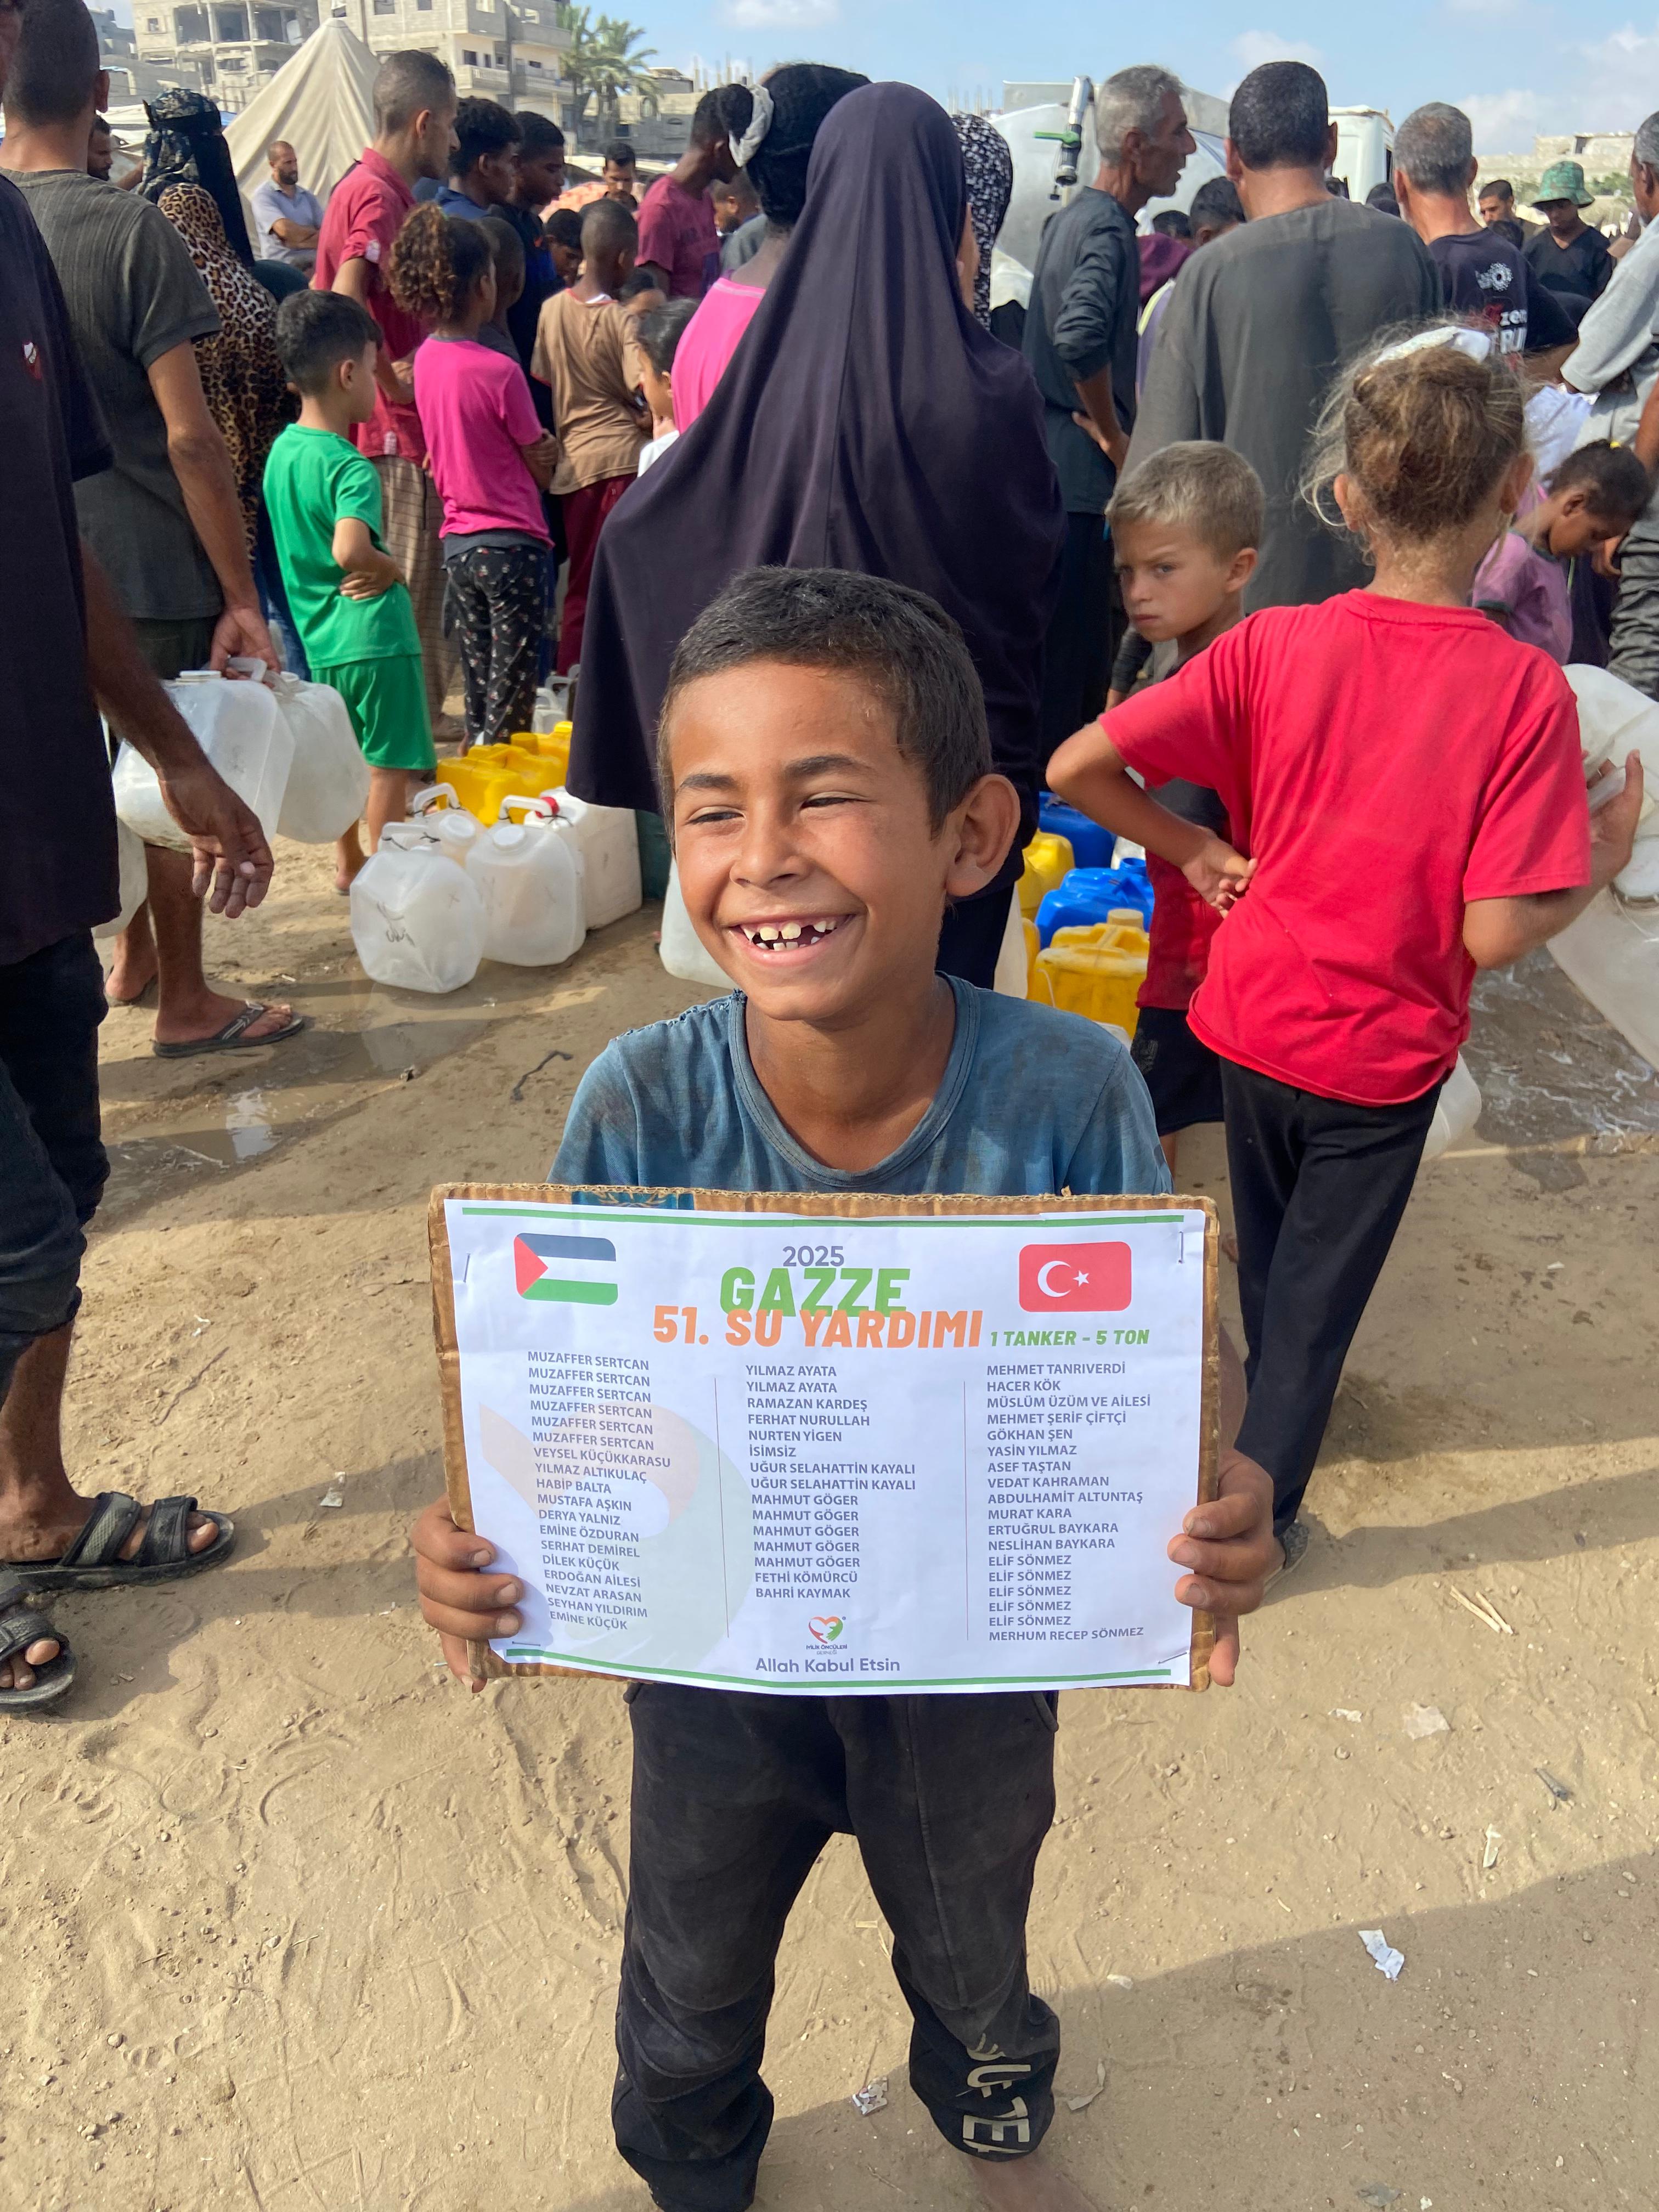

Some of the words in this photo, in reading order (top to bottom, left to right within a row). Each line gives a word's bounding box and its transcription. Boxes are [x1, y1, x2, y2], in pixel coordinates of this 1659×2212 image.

[783, 1246, 844, 1267] 2025
[719, 1267, 911, 1317] GAZZE
[653, 1306, 708, 1345] 51.
[725, 1310, 783, 1347] SU
[799, 1310, 983, 1348] YARDIMI
[991, 1331, 998, 1346] 1
[1002, 1330, 1077, 1346] TANKER
[1096, 1330, 1107, 1345] 5
[1112, 1329, 1150, 1345] TON
[528, 1351, 592, 1365] MUZAFFER
[595, 1356, 649, 1370] SERTCAN
[746, 1365, 795, 1376] YILMAZ
[798, 1365, 837, 1376] AYATA
[987, 1364, 1045, 1375] MEHMET
[1046, 1361, 1125, 1374] TANRIVERDİ
[529, 1368, 594, 1381] MUZAFFER
[596, 1373, 650, 1386] SERTCAN
[746, 1381, 795, 1392] YILMAZ
[798, 1379, 837, 1393] AYATA
[988, 1379, 1032, 1392] HACER
[1034, 1378, 1060, 1391] KÖK
[530, 1384, 594, 1398] MUZAFFER
[597, 1389, 651, 1402] SERTCAN
[747, 1398, 812, 1409] RAMAZAN
[816, 1399, 867, 1412] KARDEŞ
[988, 1395, 1045, 1408] MÜSLÜM
[1048, 1395, 1088, 1407] ÜZÜM
[1091, 1397, 1108, 1407] VE
[1111, 1394, 1150, 1407] AİLESİ
[531, 1400, 595, 1413] MUZAFFER
[597, 1403, 652, 1419] SERTCAN
[748, 1412, 797, 1425] FERHAT
[799, 1413, 870, 1426] NURULLAH
[988, 1413, 1045, 1424] MEHMET
[1047, 1410, 1082, 1426] ŞERİF
[1086, 1410, 1126, 1425] ÇİFTÇİ
[532, 1416, 596, 1430] MUZAFFER
[599, 1418, 653, 1435] SERTCAN
[533, 1432, 597, 1446] MUZAFFER
[600, 1436, 654, 1450] SERTCAN
[749, 1430, 800, 1441] NURTEN
[803, 1429, 842, 1442] YİGEN
[988, 1428, 1045, 1440] GÖKHAN
[1048, 1429, 1073, 1442] ŞEN
[749, 1444, 797, 1457] İSİMSİZ
[988, 1443, 1025, 1457] YASİN
[1028, 1445, 1077, 1455] YILMAZ
[534, 1447, 578, 1459] VEYSEL
[580, 1448, 670, 1468] KÜÇÜKKARASU
[535, 1463, 580, 1476] YILMAZ
[583, 1466, 647, 1484] ALTIKULAÇ
[751, 1460, 787, 1475] UĞUR
[790, 1462, 867, 1474] SELAHATTİN
[871, 1464, 915, 1476] KAYALI
[988, 1462, 1019, 1472] ASEF
[1022, 1460, 1070, 1474] TAŞTAN
[537, 1477, 572, 1490] HABİP
[575, 1481, 612, 1494] BALTA
[751, 1476, 788, 1489] UĞUR
[789, 1477, 870, 1491] SELAHATTİN
[871, 1479, 915, 1489] KAYALI
[988, 1478, 1030, 1488] VEDAT
[1033, 1476, 1109, 1487] KAHRAMAN
[538, 1494, 593, 1508] MUSTAFA
[596, 1499, 631, 1512] AŞKIN
[752, 1493, 812, 1506] MAHMUT
[814, 1492, 858, 1505] GÖGER
[988, 1490, 1075, 1504] ABDULHAMİT
[1077, 1492, 1143, 1504] ALTUNTAŞ
[539, 1510, 577, 1522] DERYA
[578, 1512, 620, 1525] YALNIZ
[753, 1508, 811, 1521] MAHMUT
[814, 1508, 859, 1521] GÖGER
[988, 1509, 1034, 1520] MURAT
[1037, 1508, 1072, 1519] KARA
[540, 1523, 577, 1537] EMİNE
[579, 1526, 639, 1542] ÖZDURAN
[753, 1526, 811, 1537] MAHMUT
[815, 1524, 859, 1537] GÖGER
[989, 1522, 1056, 1535] ERTUĞRUL
[1059, 1523, 1118, 1533] BAYKARA
[541, 1541, 585, 1553] SERHAT
[587, 1543, 640, 1558] DEMİREL
[754, 1541, 812, 1552] MAHMUT
[815, 1539, 860, 1552] GÖGER
[989, 1538, 1052, 1550] NESLİHAN
[1056, 1538, 1115, 1549] BAYKARA
[543, 1554, 577, 1567] DİLEK
[578, 1556, 620, 1572] KÜÇÜK
[755, 1556, 813, 1567] MAHMUT
[816, 1555, 860, 1567] GÖGER
[989, 1554, 1014, 1566] ELİF
[1017, 1554, 1071, 1566] SÖNMEZ
[544, 1570, 601, 1584] ERDOĞAN
[605, 1574, 640, 1588] AİLESİ
[755, 1571, 790, 1583] FETHİ
[793, 1571, 857, 1583] KÖMÜRCÜ
[989, 1570, 1014, 1582] ELİF
[1017, 1569, 1071, 1581] SÖNMEZ
[546, 1583, 590, 1598] NEVZAT
[593, 1589, 641, 1602] ARASAN
[756, 1586, 794, 1598] BAHRİ
[797, 1588, 850, 1598] KAYMAK
[989, 1585, 1014, 1597] ELİF
[1017, 1584, 1071, 1597] SÖNMEZ
[548, 1598, 592, 1612] SEYHAN
[595, 1604, 647, 1617] YILDIRIM
[989, 1600, 1014, 1612] ELİF
[1017, 1599, 1071, 1611] SÖNMEZ
[550, 1611, 584, 1624] EMİNE
[587, 1616, 628, 1630] KÜÇÜK
[989, 1615, 1014, 1626] ELİF
[1017, 1614, 1071, 1626] SÖNMEZ
[989, 1631, 1046, 1641] MERHUM
[1050, 1631, 1088, 1640] RECEP
[1092, 1627, 1143, 1639] SÖNMEZ
[755, 1658, 799, 1672] Allah
[805, 1658, 854, 1672] Kabul
[860, 1658, 900, 1671] Etsin
